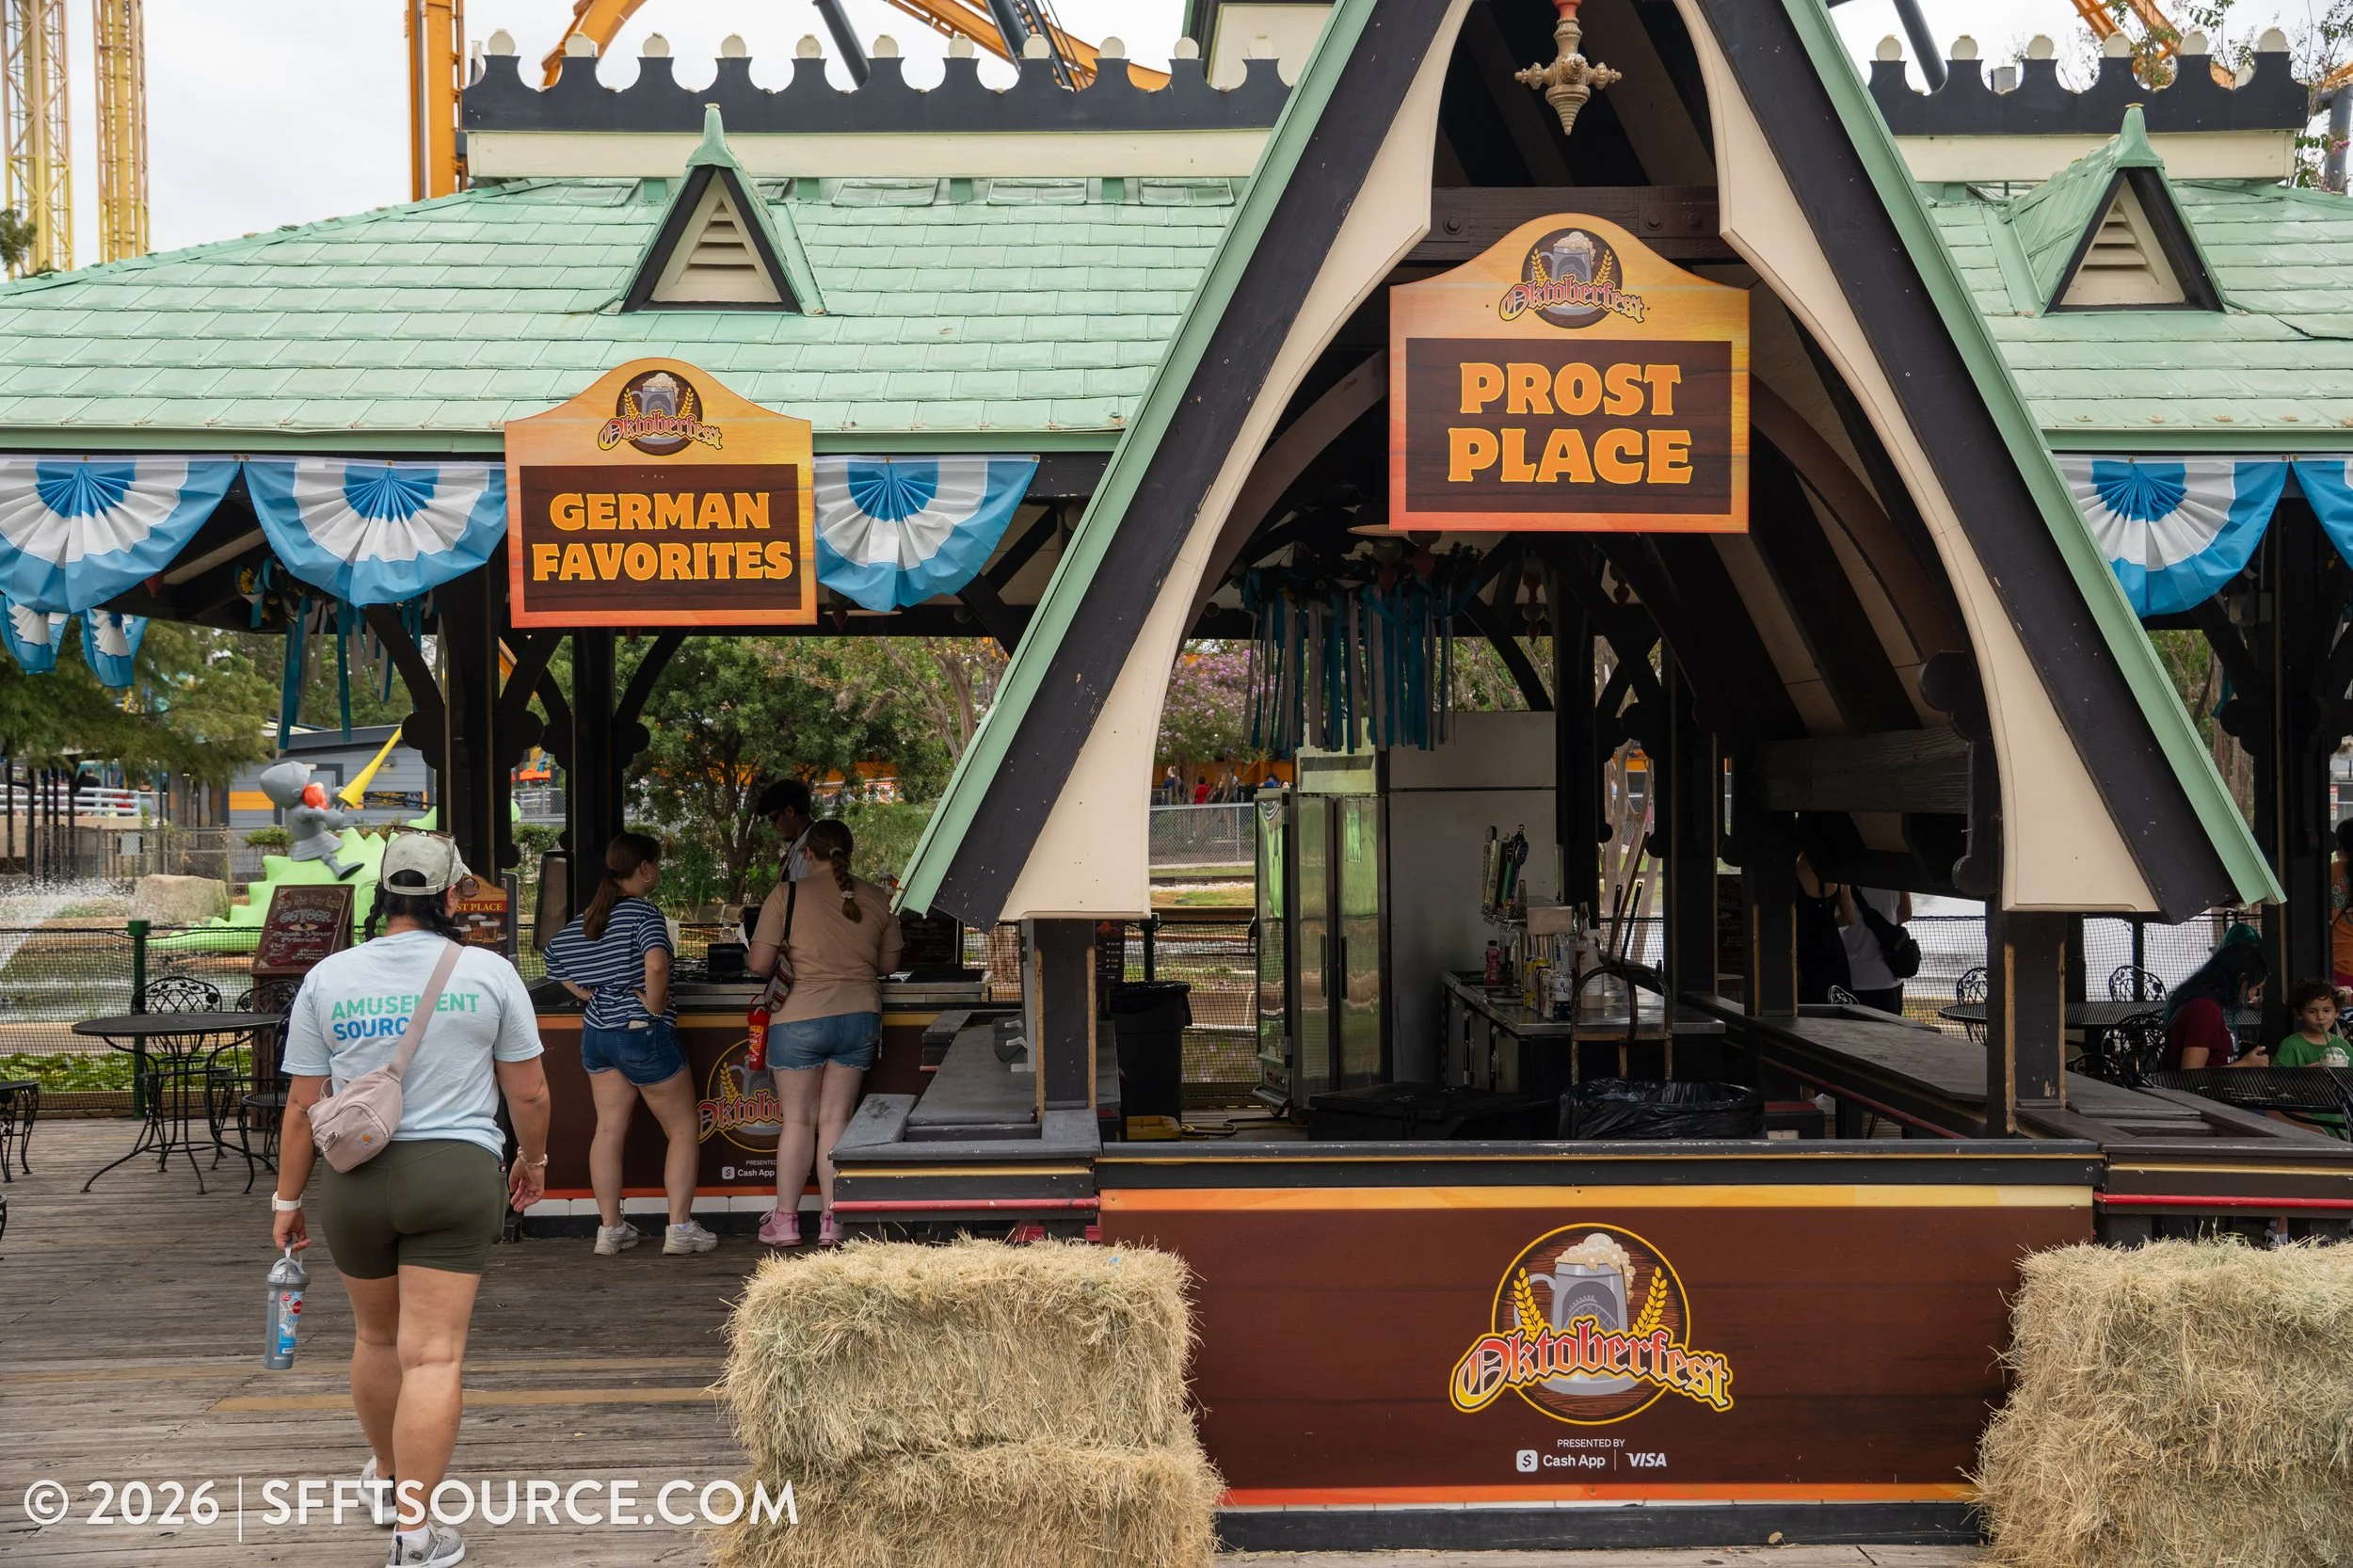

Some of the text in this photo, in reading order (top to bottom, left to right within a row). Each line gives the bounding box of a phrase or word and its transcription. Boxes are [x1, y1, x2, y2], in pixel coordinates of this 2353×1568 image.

[1500, 276, 1643, 322] Oktoberfest
[1460, 361, 1682, 416] PROST
[599, 410, 722, 450] Oktoberfest
[1448, 427, 1693, 485] PLACE
[549, 492, 771, 532] GERMAN
[532, 541, 792, 582] FAVORITES
[471, 903, 503, 911] PLACE
[333, 1016, 410, 1041] SOURC
[737, 1168, 758, 1177] Cash
[758, 1168, 776, 1178] App
[1451, 1318, 1731, 1410] Oktoberfest
[1543, 1454, 1576, 1467] Cash
[1577, 1454, 1606, 1469] App
[1625, 1452, 1668, 1467] VISA
[1557, 1438, 1625, 1448] PRESENTED BY
